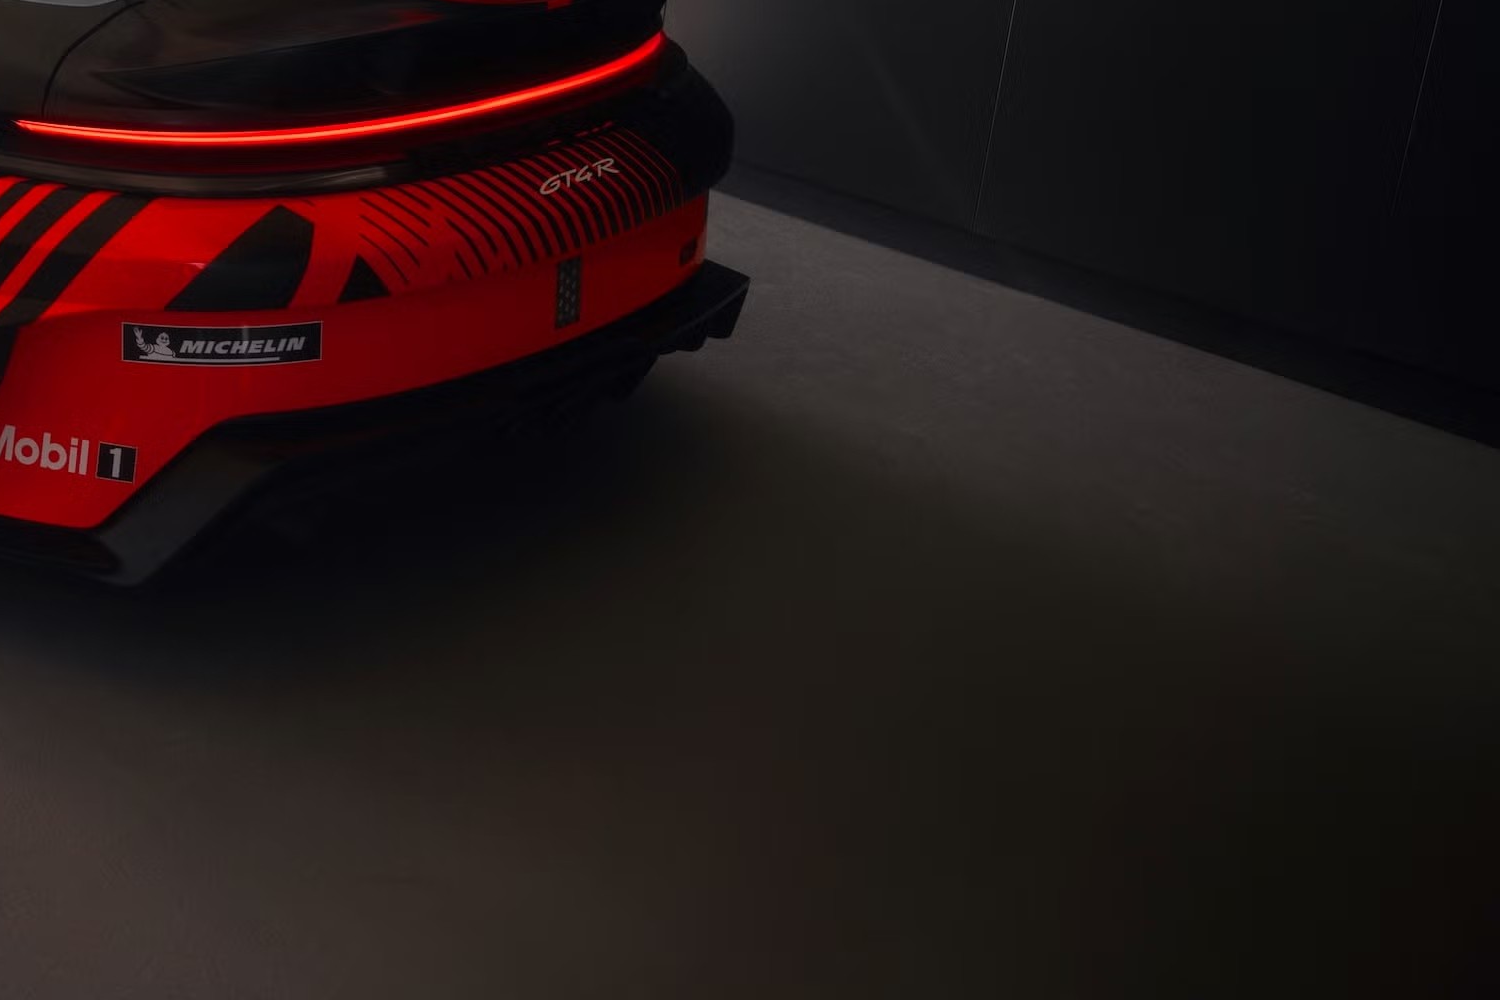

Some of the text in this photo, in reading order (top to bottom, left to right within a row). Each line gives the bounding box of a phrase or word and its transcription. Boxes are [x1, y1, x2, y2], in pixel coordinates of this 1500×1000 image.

[540, 158, 619, 195] GT4R
[180, 336, 306, 354] MICHELIN
[109, 447, 122, 478] 1
